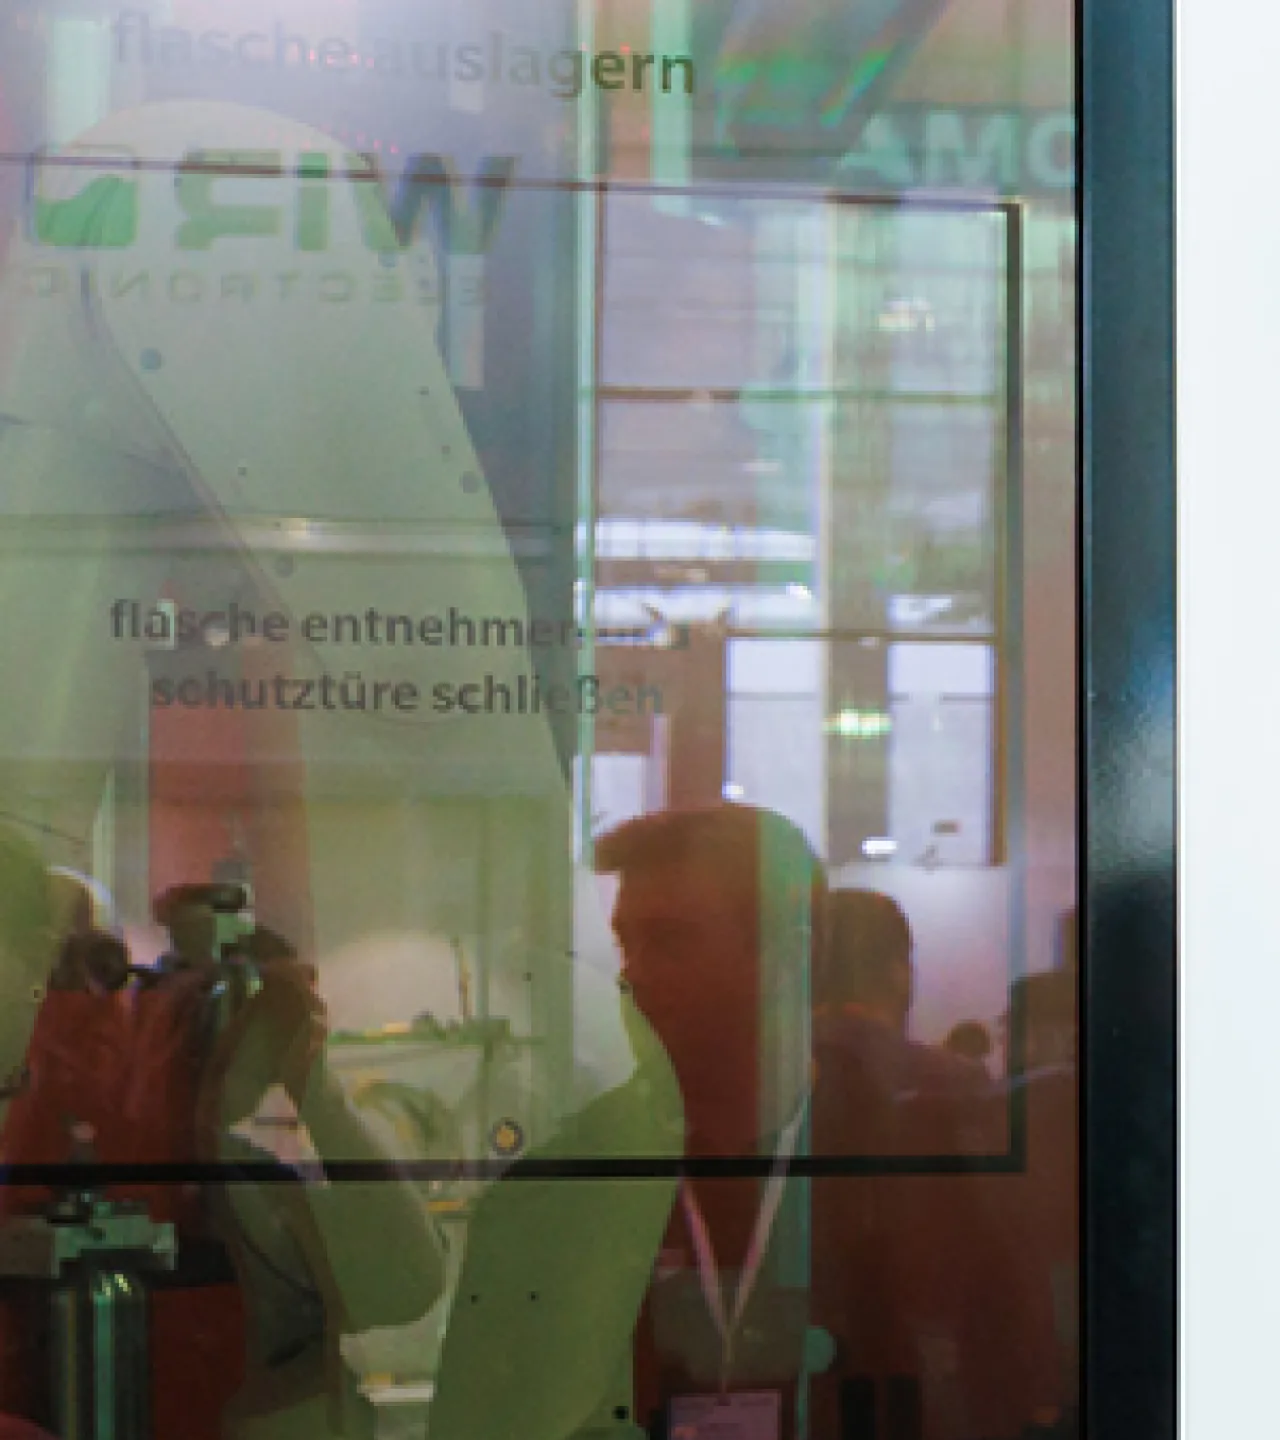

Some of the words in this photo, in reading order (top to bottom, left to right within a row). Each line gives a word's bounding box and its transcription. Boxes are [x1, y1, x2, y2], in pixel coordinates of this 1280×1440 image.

[112, 11, 352, 68] flasche
[374, 31, 694, 98] auslagern
[110, 599, 291, 642] flasche
[150, 671, 419, 714] schutztüre
[432, 674, 662, 717] schließen
